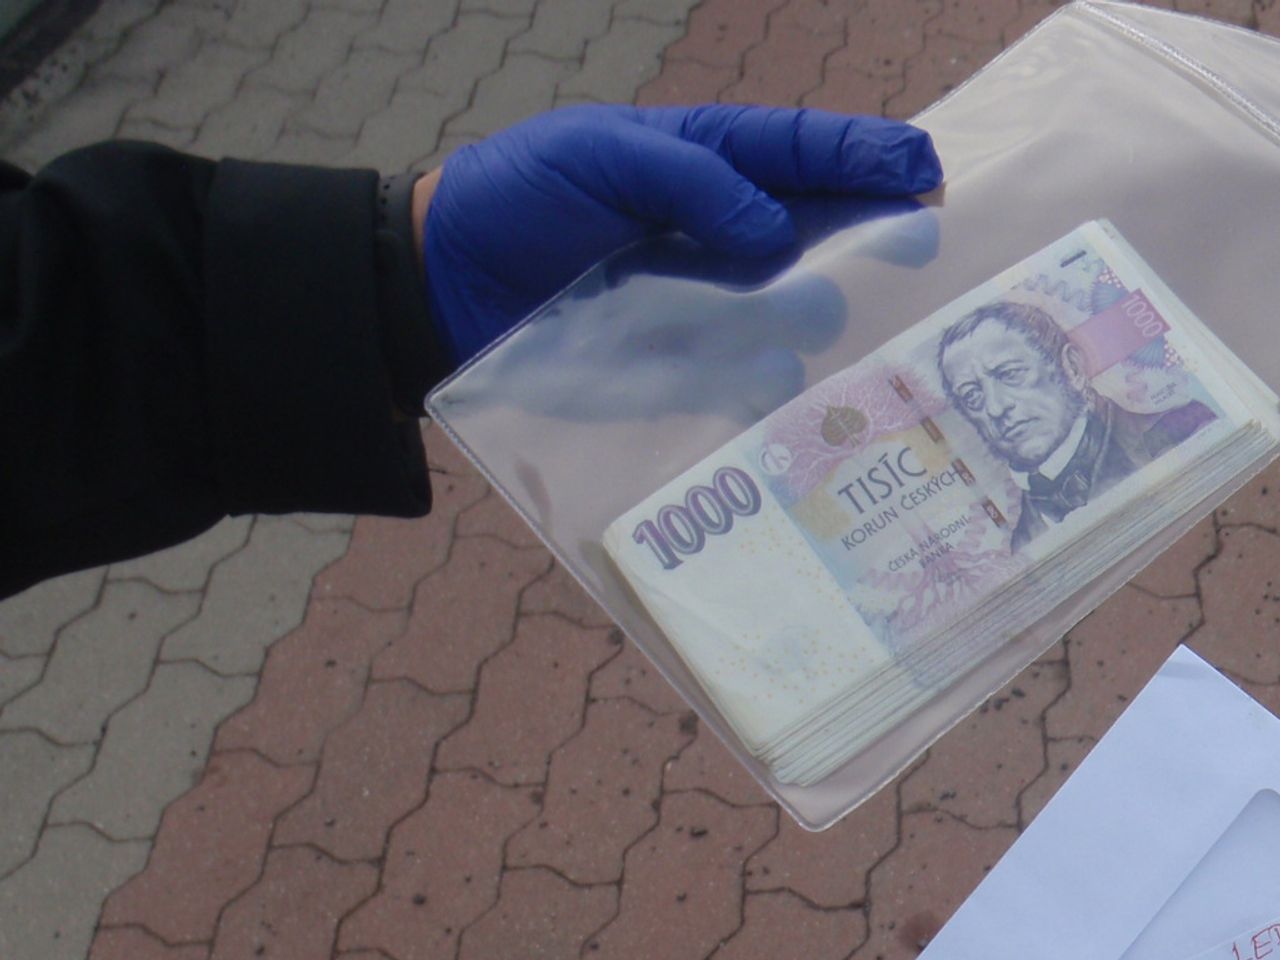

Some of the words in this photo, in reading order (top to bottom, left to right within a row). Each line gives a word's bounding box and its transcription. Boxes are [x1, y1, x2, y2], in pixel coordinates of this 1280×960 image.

[1121, 294, 1164, 339] 1000
[631, 464, 764, 572] 1000
[837, 446, 928, 515] TISÍC
[841, 506, 900, 551] KORUN
[900, 470, 960, 512] ČESKÝCH
